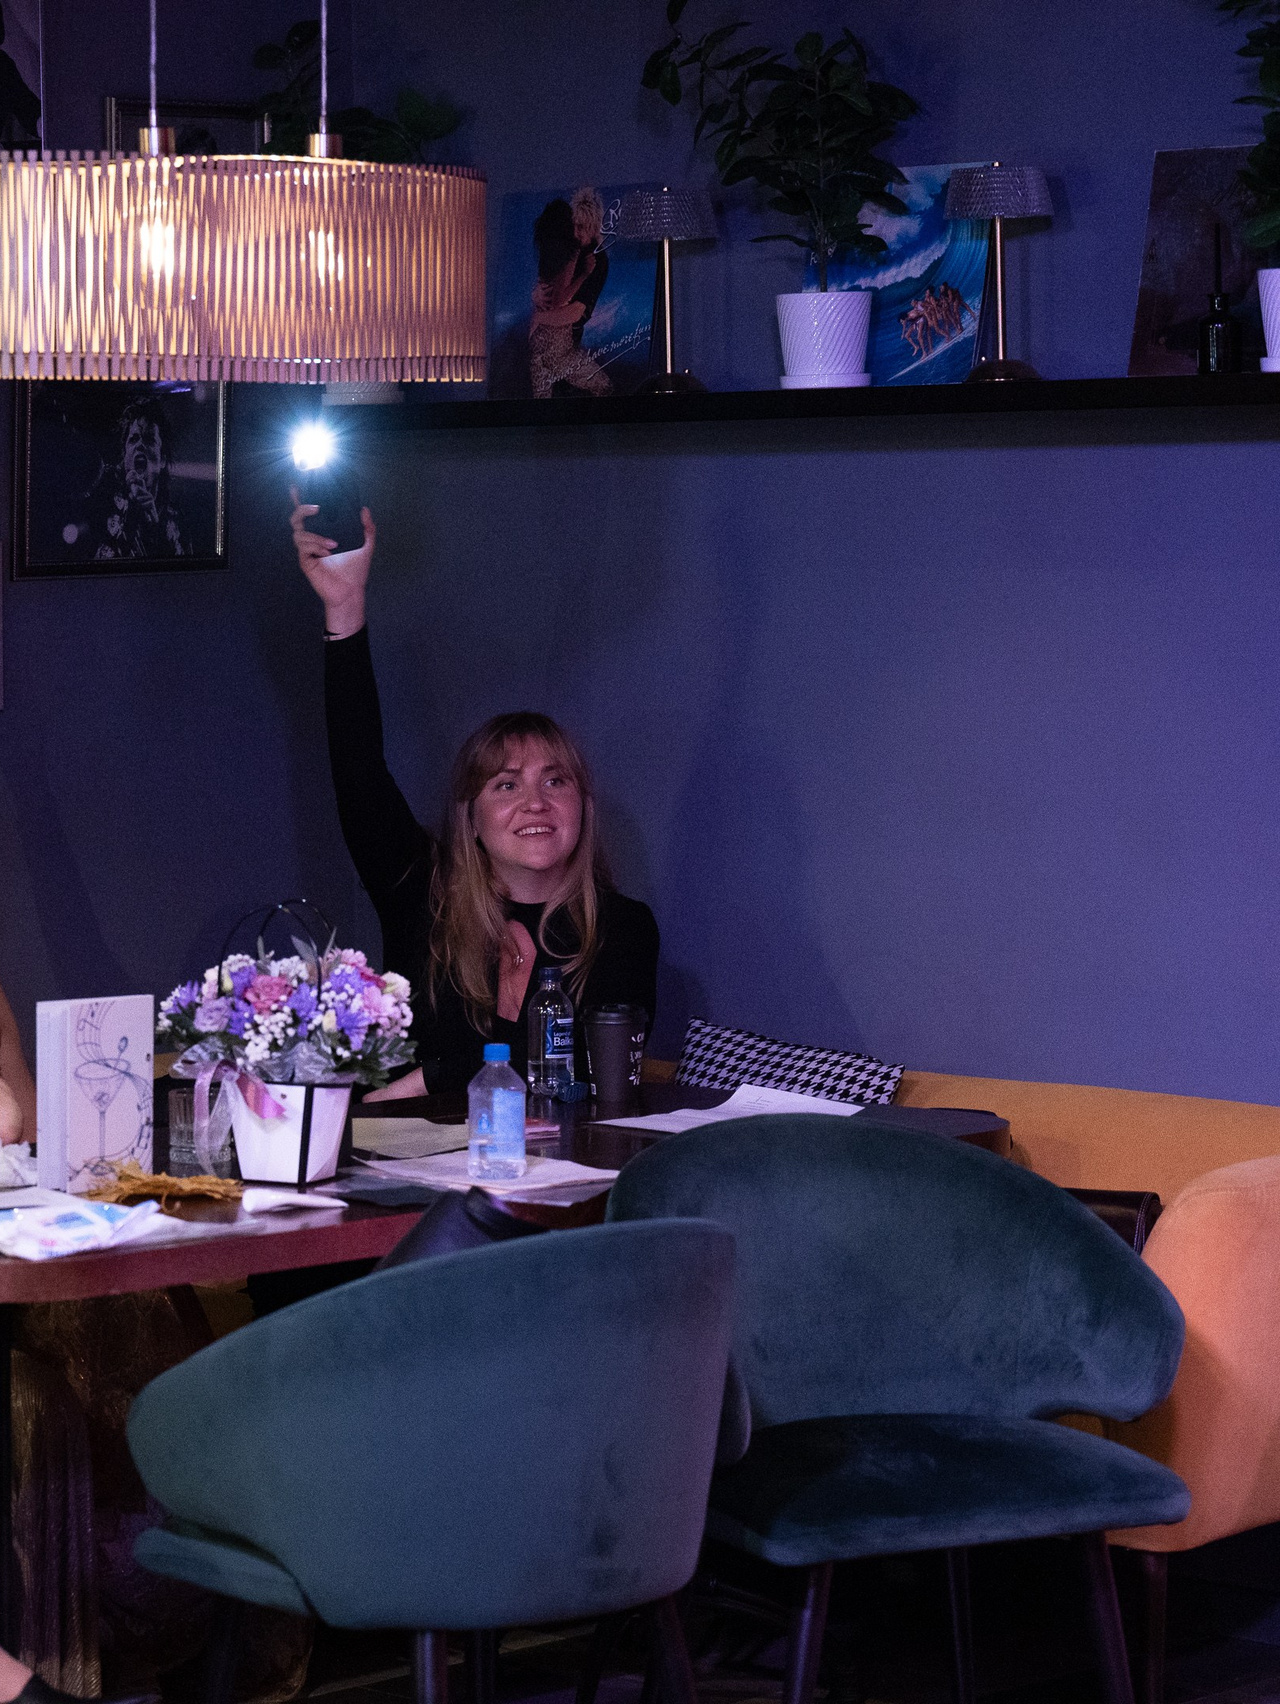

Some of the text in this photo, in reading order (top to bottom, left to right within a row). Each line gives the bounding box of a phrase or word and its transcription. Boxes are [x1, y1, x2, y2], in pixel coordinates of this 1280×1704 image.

[586, 348, 610, 365] have
[610, 332, 634, 352] more
[632, 322, 651, 350] fun
[553, 1037, 574, 1047] Baika
